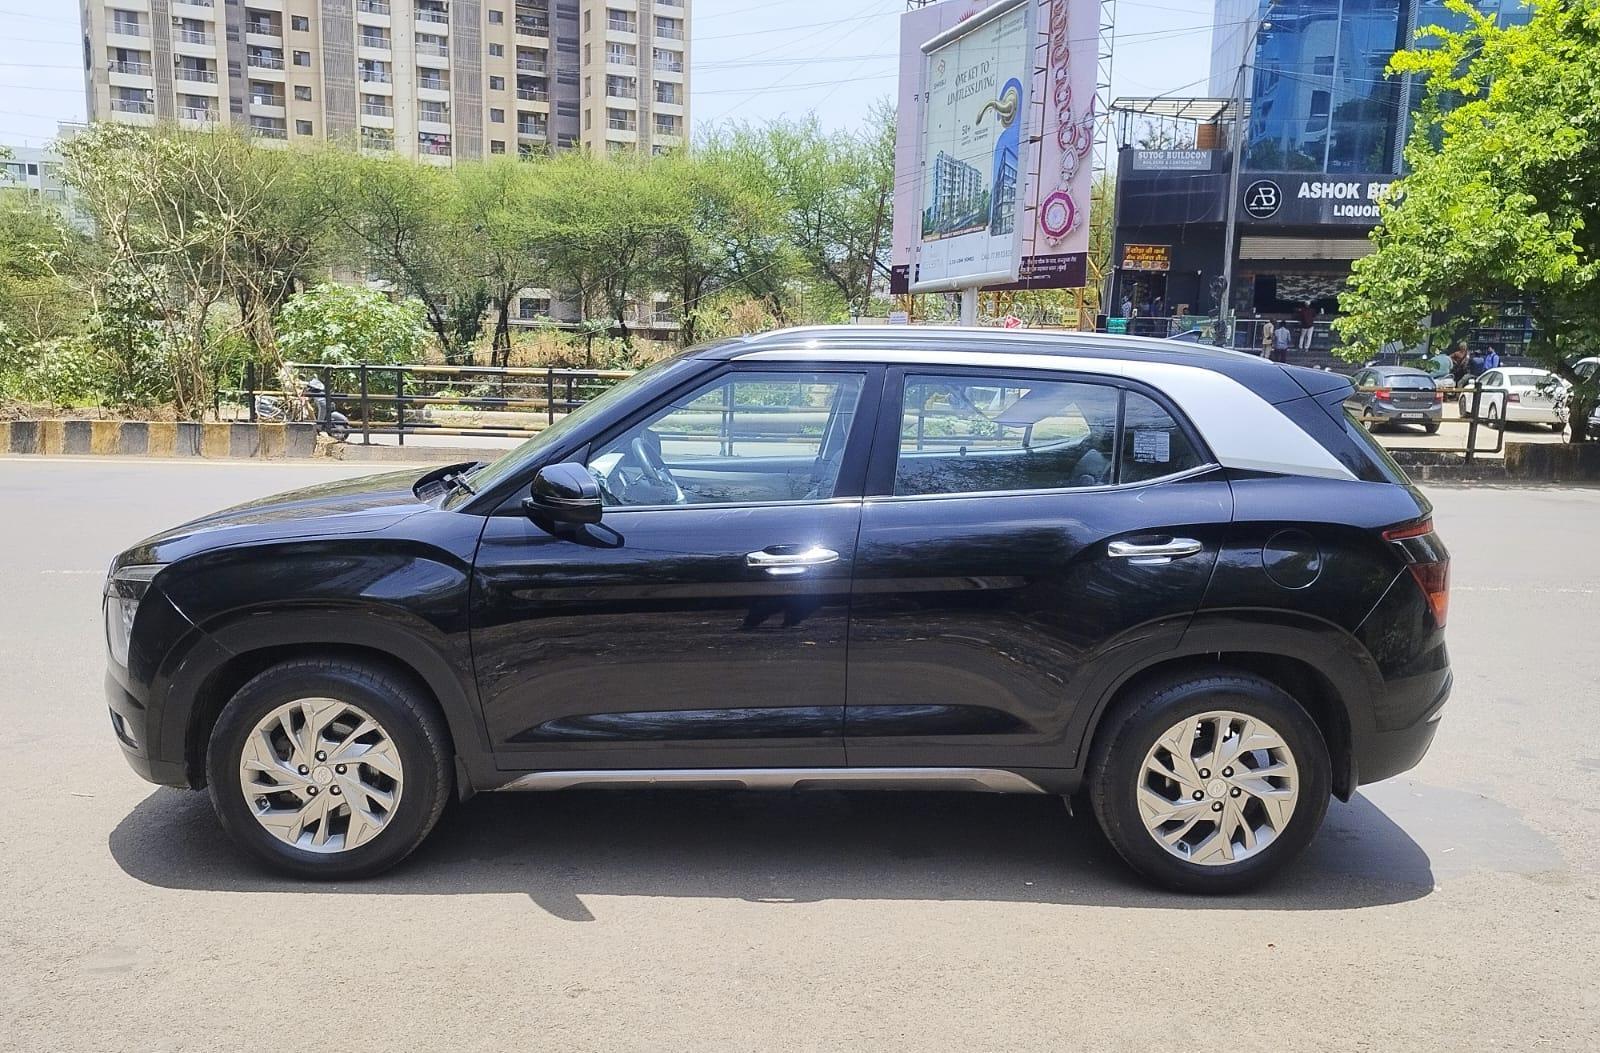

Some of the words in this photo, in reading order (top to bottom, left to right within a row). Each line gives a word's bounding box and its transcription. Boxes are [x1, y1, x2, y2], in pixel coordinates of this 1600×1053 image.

[981, 61, 990, 76] TO
[1138, 151, 1164, 159] SUYOG
[1166, 151, 1207, 159] BUILDCON
[1297, 182, 1360, 199] ASHOK
[1333, 205, 1380, 217] LIQUOR
